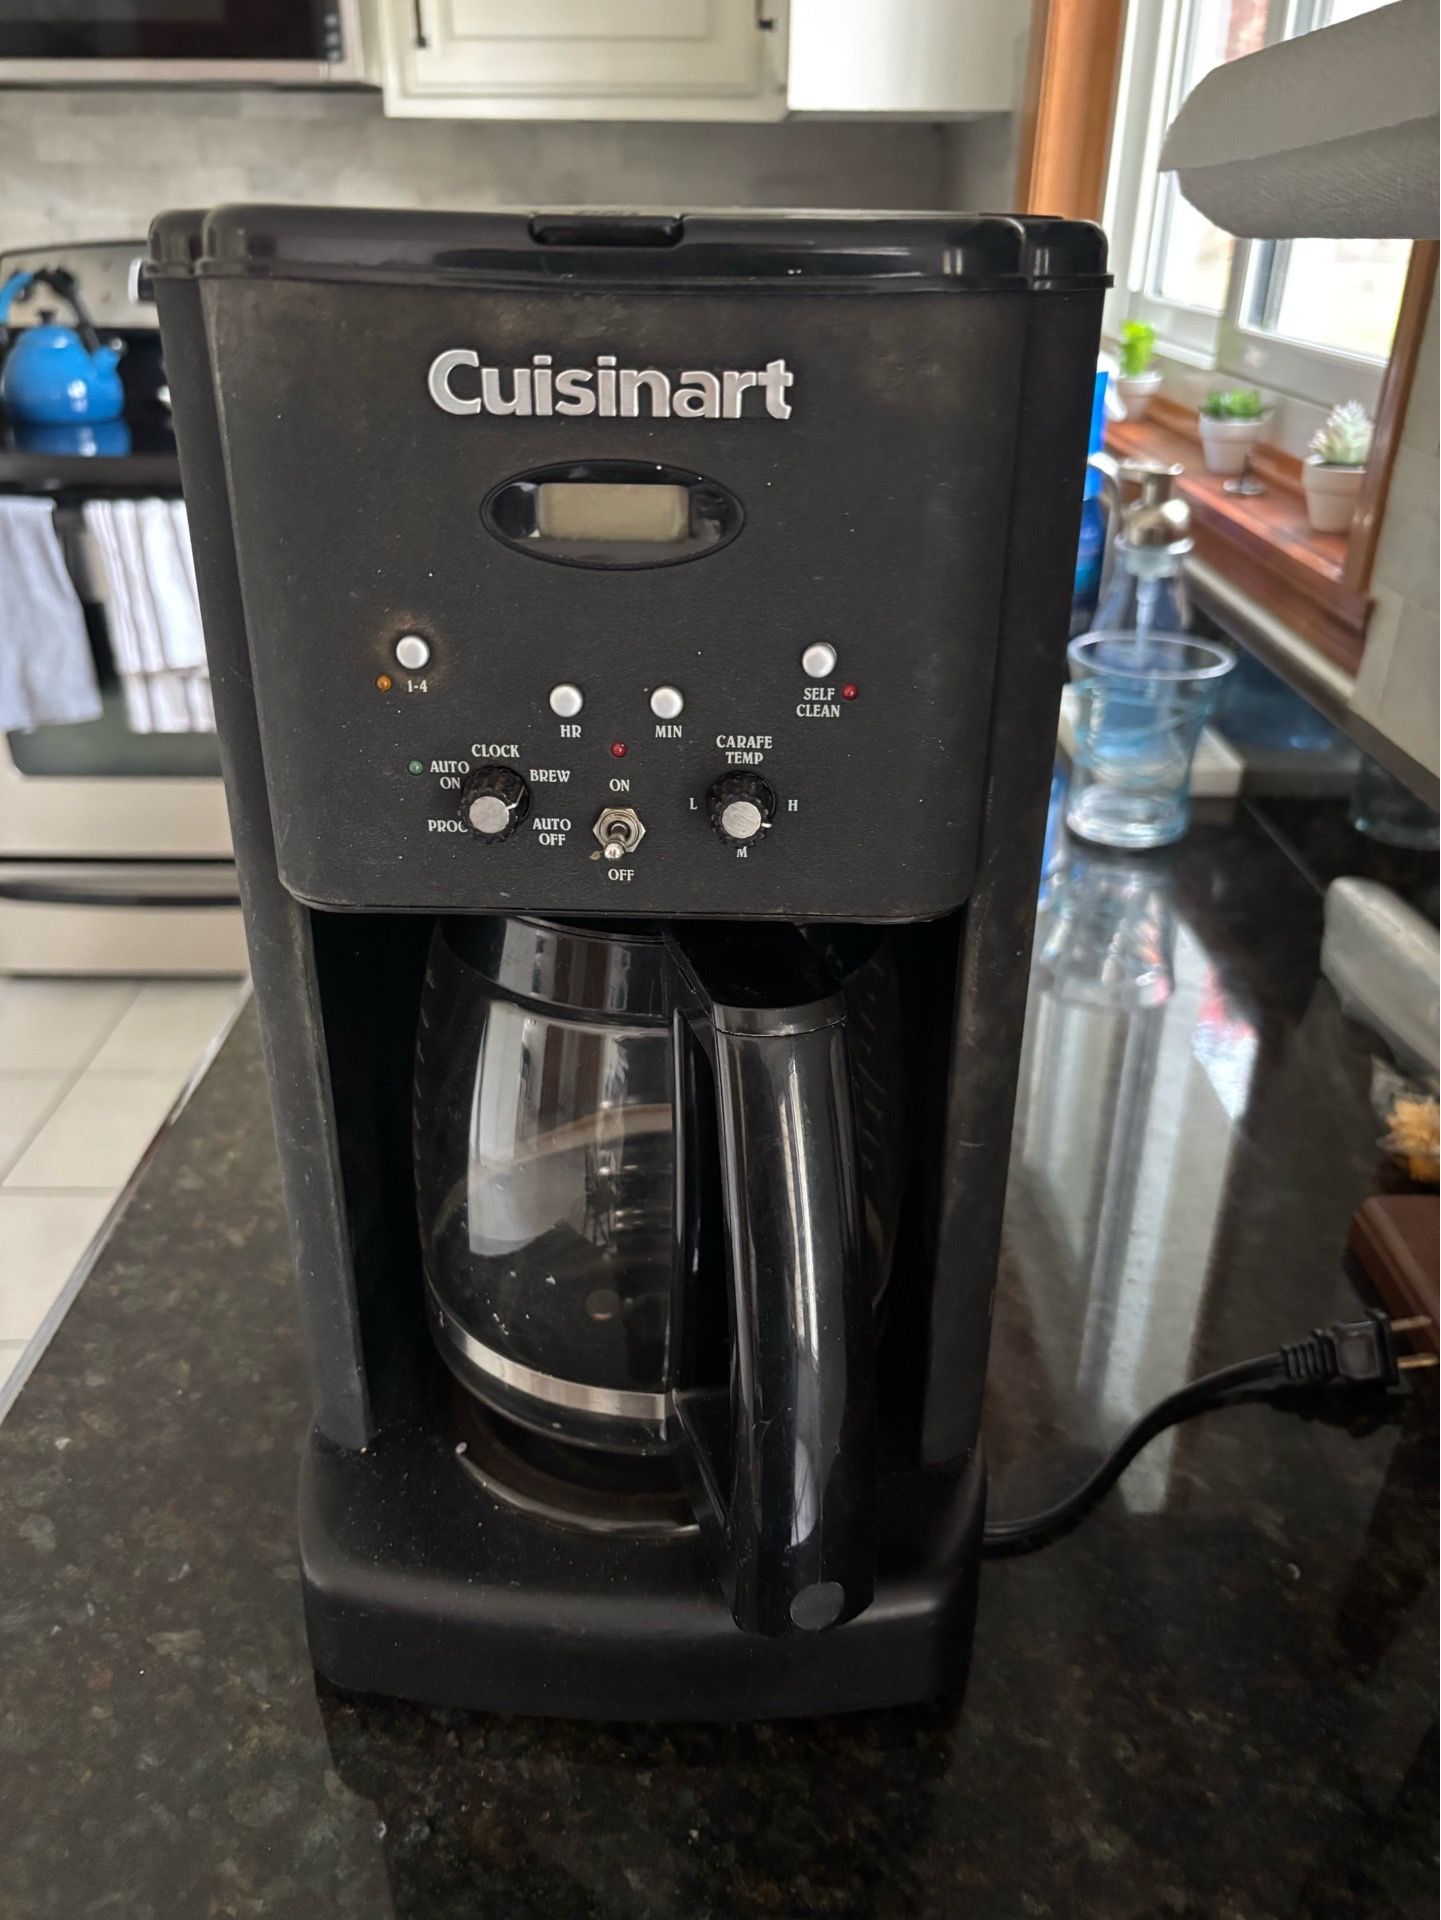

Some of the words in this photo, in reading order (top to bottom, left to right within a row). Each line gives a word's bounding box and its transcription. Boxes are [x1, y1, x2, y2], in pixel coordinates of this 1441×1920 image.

[427, 348, 794, 420] Cuisinart
[407, 680, 428, 693] 1-4
[803, 688, 836, 701] SELF
[796, 704, 841, 718] CLEAN
[560, 725, 582, 738] HR
[655, 725, 682, 739] MIN
[716, 735, 773, 749] CARAFE
[471, 744, 520, 758] CLOCK
[725, 752, 763, 765] TEMP
[430, 760, 470, 774] AUTO
[529, 769, 571, 783] BREW
[439, 777, 461, 790] ON
[609, 779, 630, 793] ON
[689, 798, 698, 810] L
[788, 799, 799, 812] H
[532, 818, 572, 831] AUTO
[538, 833, 566, 846] OFF
[736, 846, 748, 858] M
[607, 869, 635, 882] OFF
